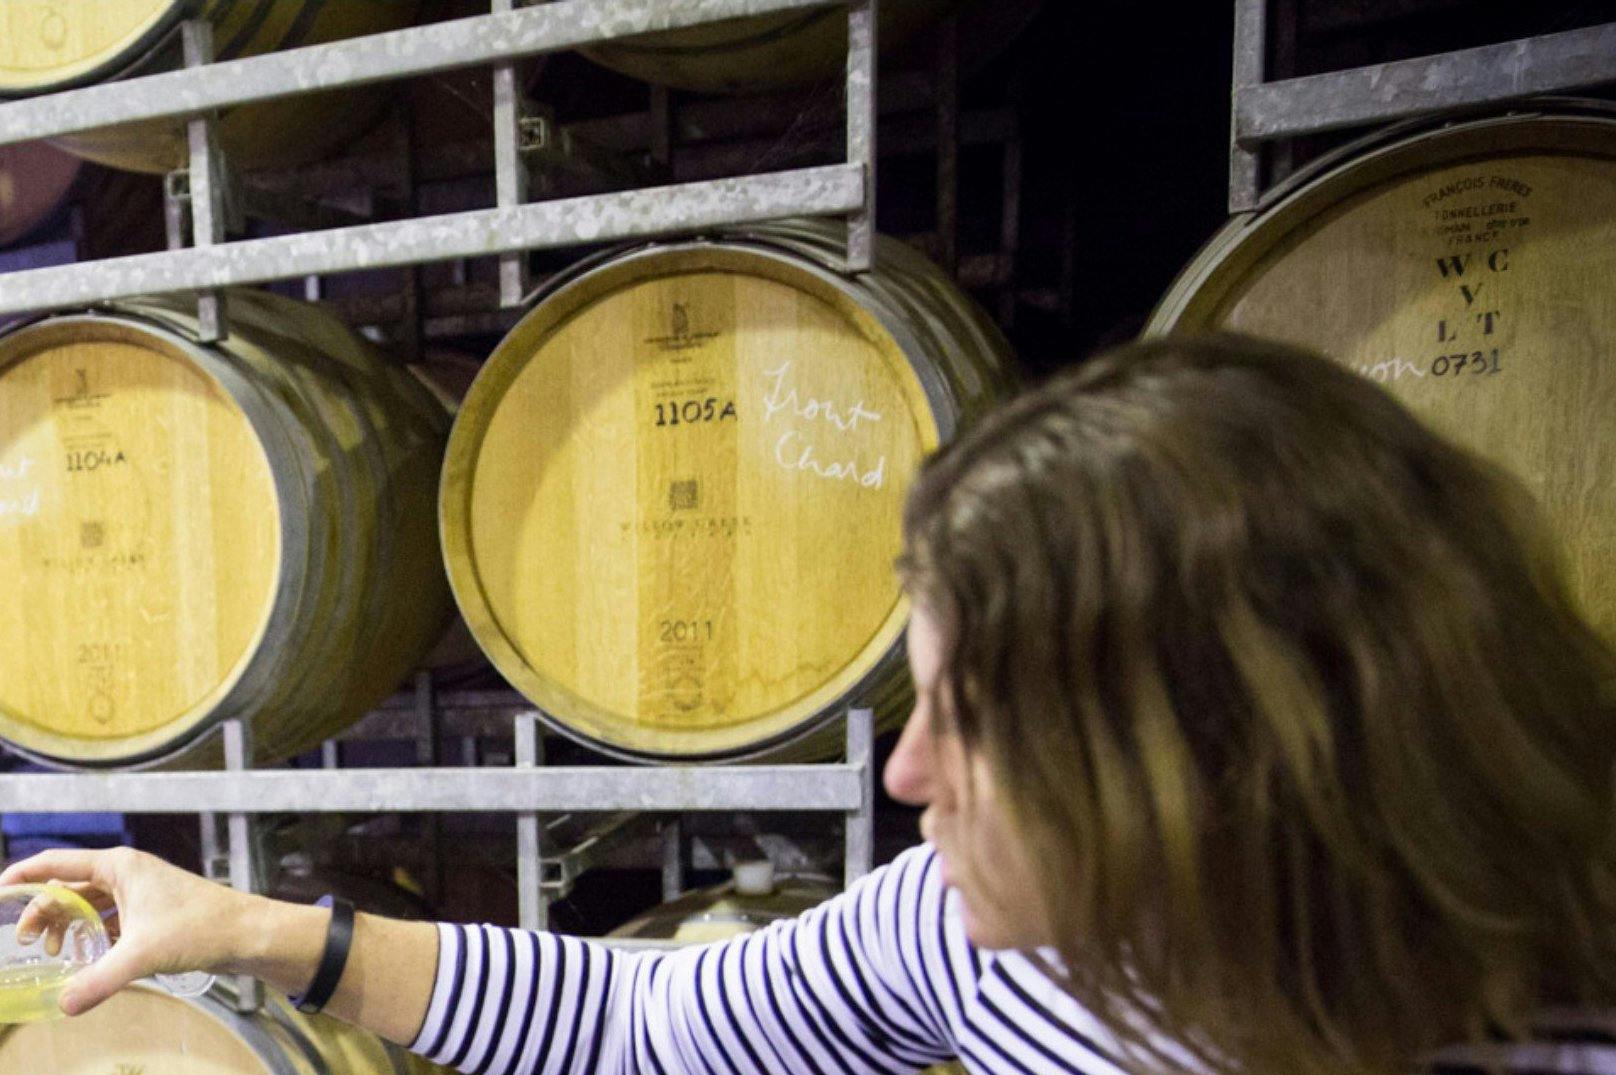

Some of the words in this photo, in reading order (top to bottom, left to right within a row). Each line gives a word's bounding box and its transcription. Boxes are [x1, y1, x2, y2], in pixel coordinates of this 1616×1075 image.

[1435, 201, 1517, 220] TONNELLERIE
[1436, 252, 1473, 279] W
[1487, 248, 1510, 273] C
[1459, 281, 1484, 309] V
[1437, 319, 1459, 344] L
[1476, 309, 1502, 336] T
[1430, 345, 1504, 378] 0731
[654, 396, 739, 428] 1105A
[64, 449, 128, 473] 1104A
[775, 432, 885, 490] Chard
[659, 618, 714, 644] 2011
